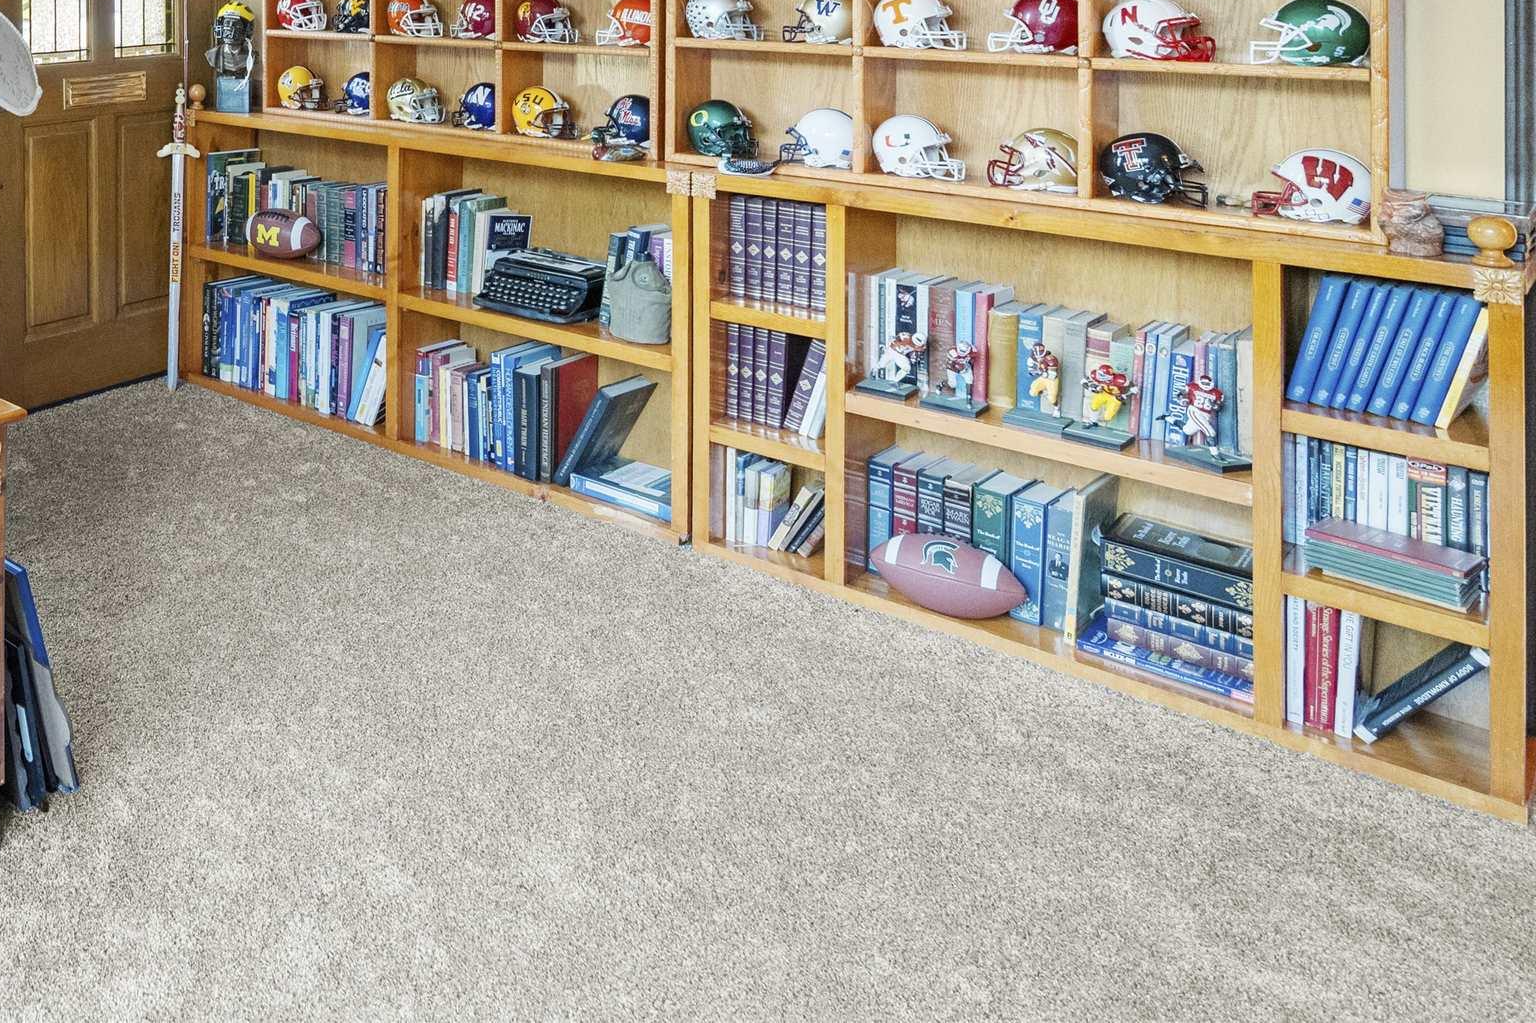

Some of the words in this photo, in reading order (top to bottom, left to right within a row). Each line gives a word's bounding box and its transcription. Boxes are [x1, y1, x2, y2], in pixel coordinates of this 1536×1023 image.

[1120, 5, 1138, 26] N
[1301, 155, 1354, 202] W
[256, 223, 281, 247] M
[495, 222, 526, 233] MACKINAC
[1421, 487, 1441, 546] VIETNAM
[1451, 496, 1464, 543] HAUNTING
[1320, 608, 1333, 633] Strange
[1321, 633, 1333, 658] Stories
[1414, 679, 1450, 706] KNOWLEDGE
